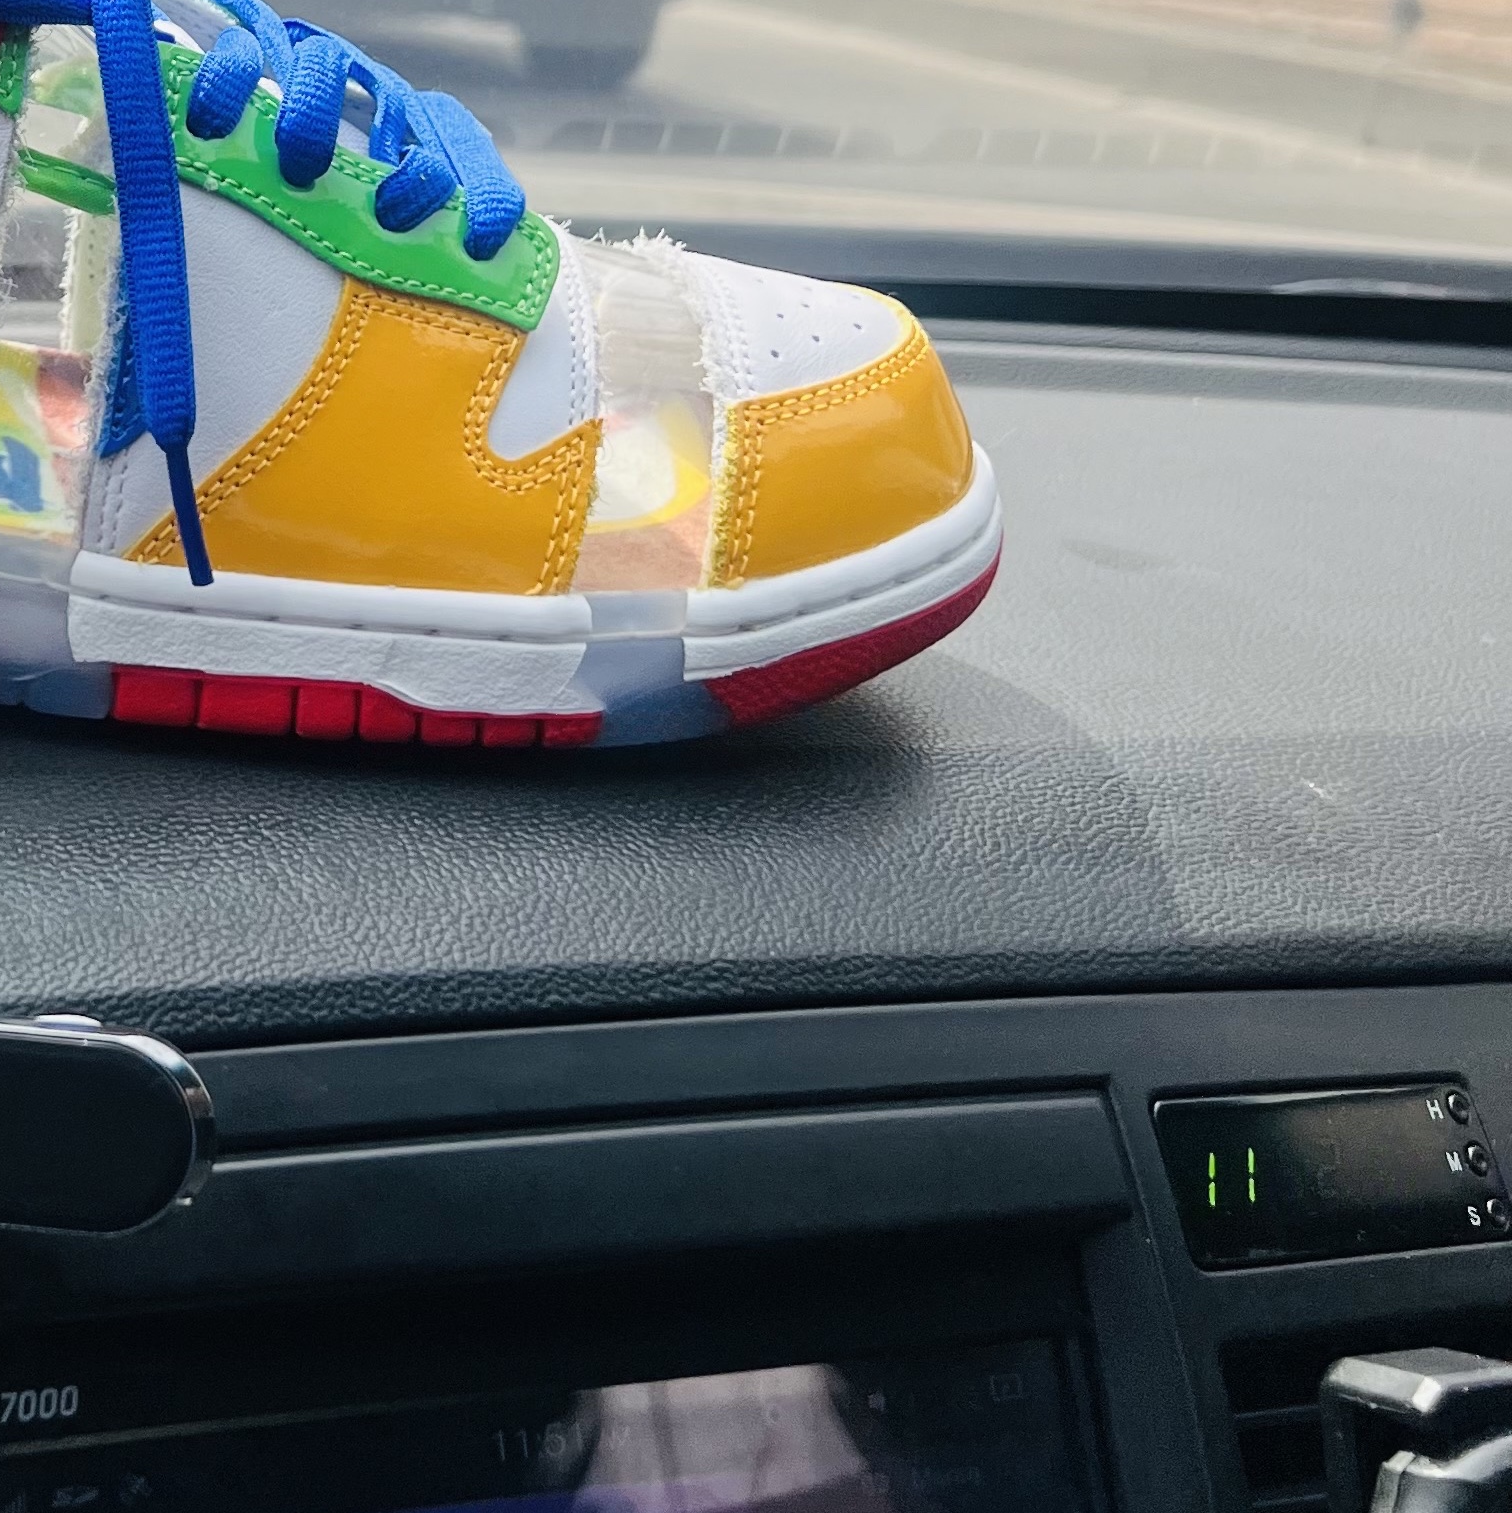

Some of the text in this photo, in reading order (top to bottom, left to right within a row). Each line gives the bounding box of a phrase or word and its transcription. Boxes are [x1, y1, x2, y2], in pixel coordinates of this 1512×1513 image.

[1427, 1100, 1444, 1120] H
[1446, 1151, 1463, 1172] M
[1467, 1207, 1481, 1227] S
